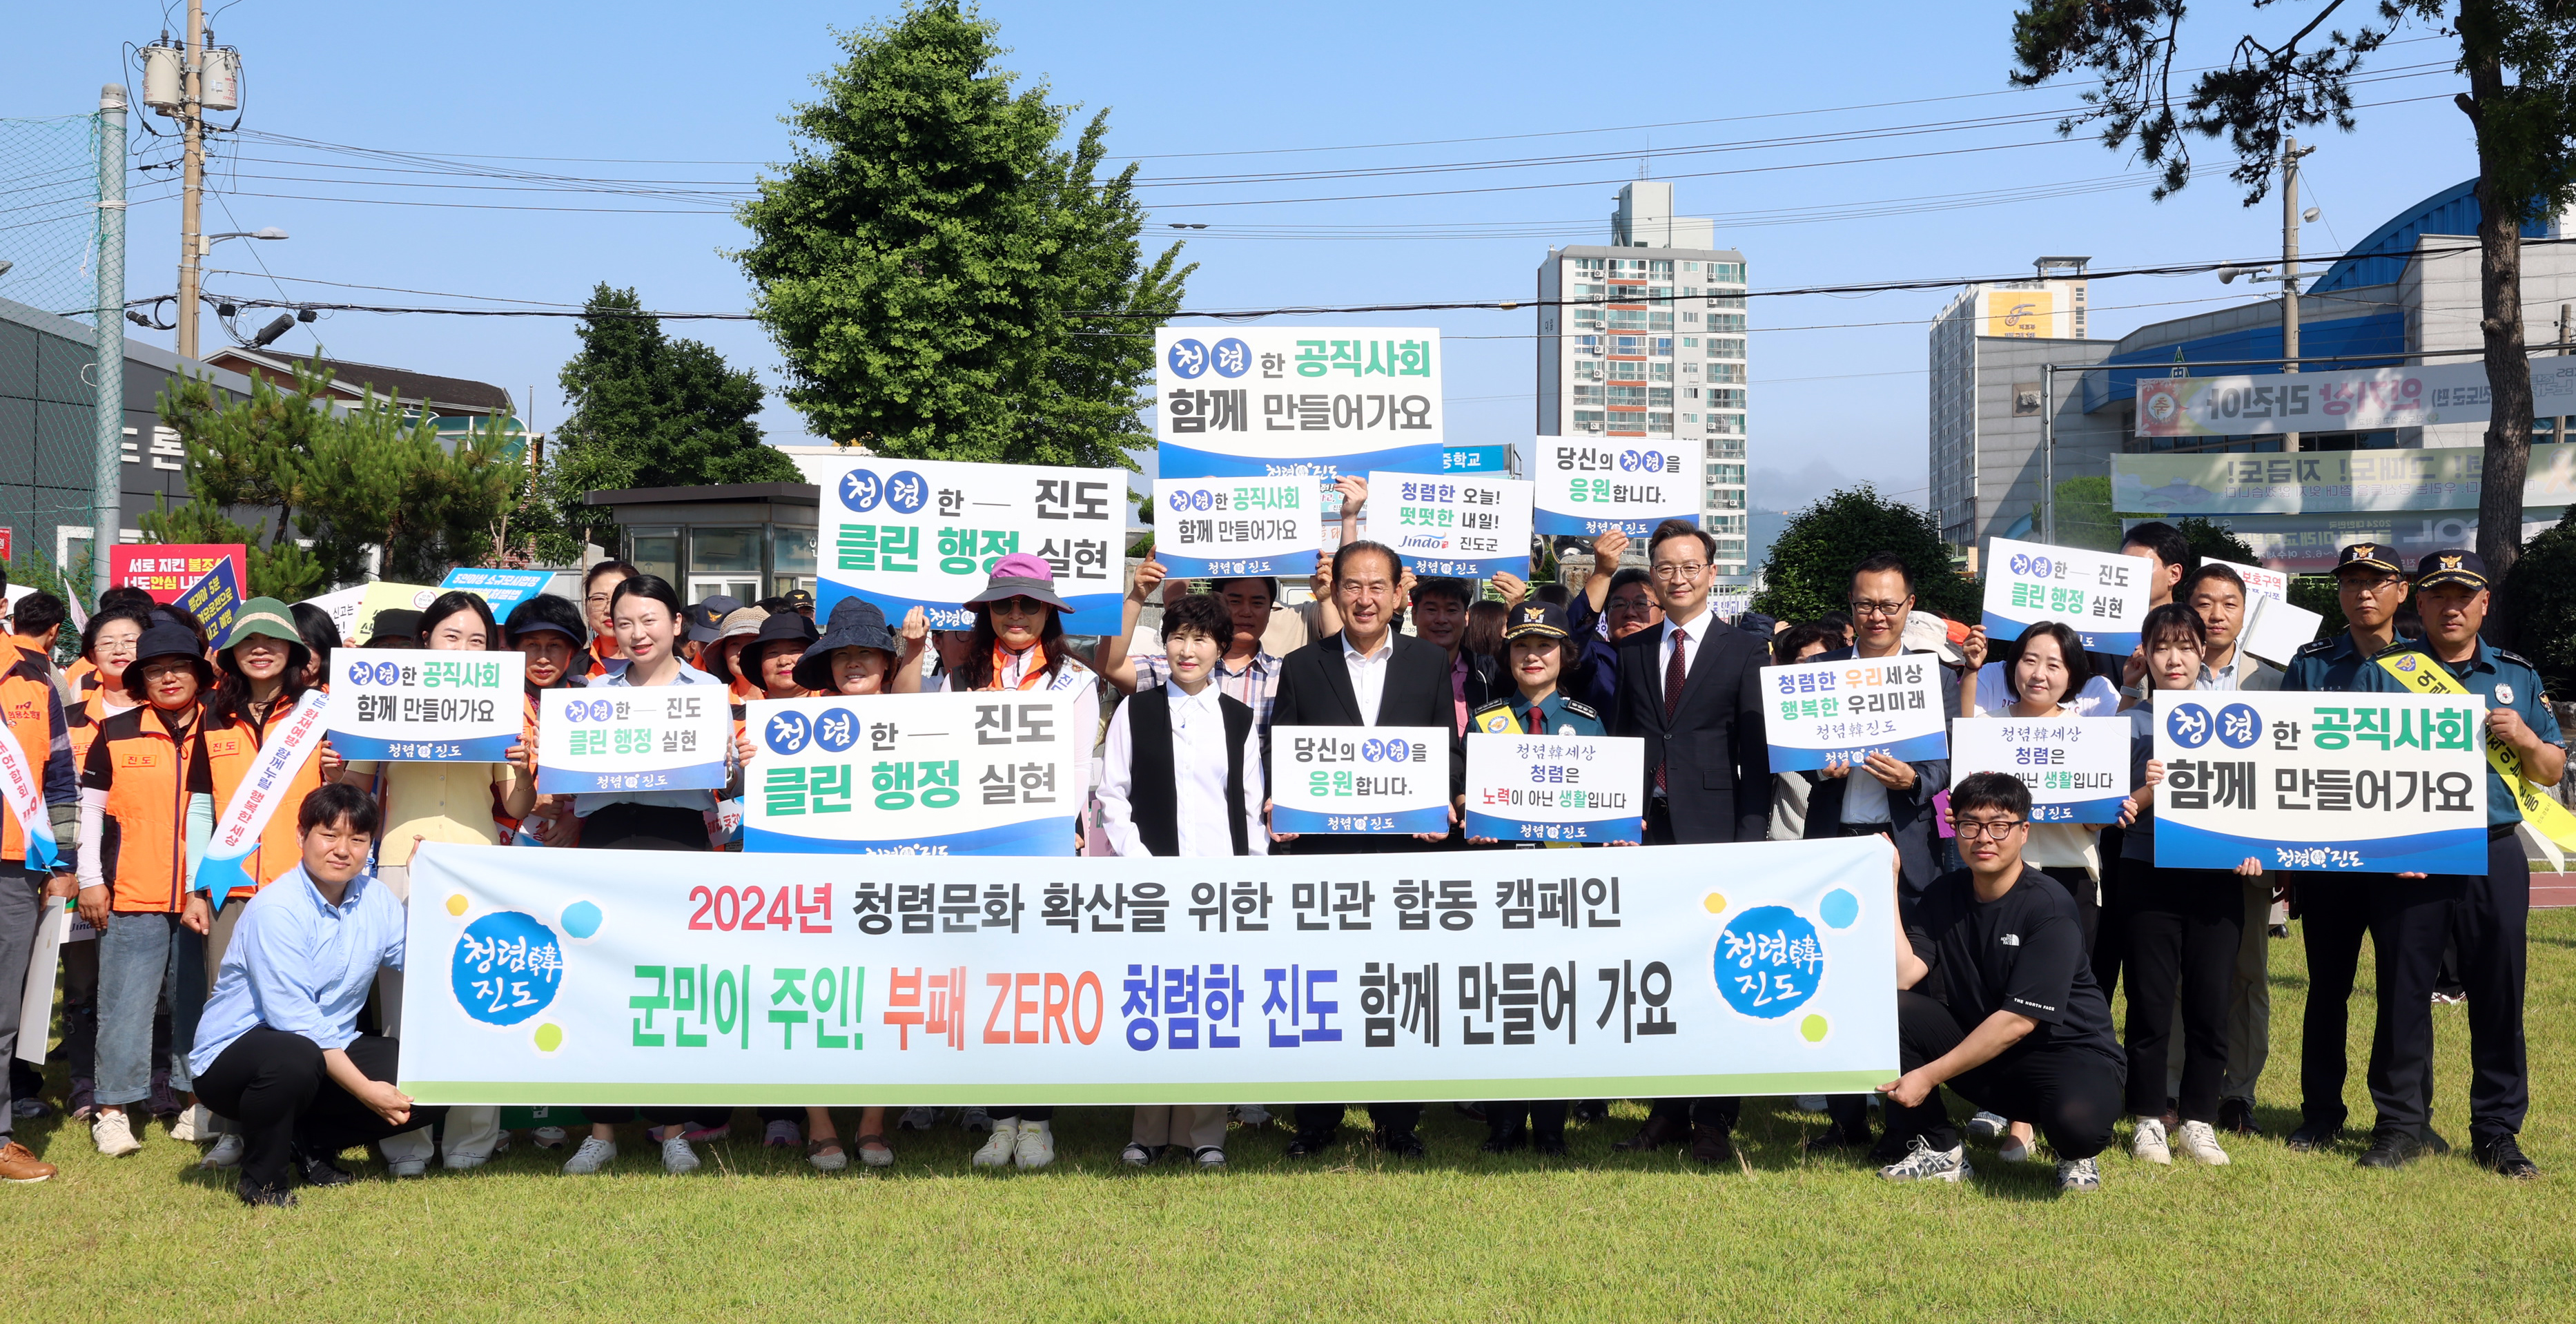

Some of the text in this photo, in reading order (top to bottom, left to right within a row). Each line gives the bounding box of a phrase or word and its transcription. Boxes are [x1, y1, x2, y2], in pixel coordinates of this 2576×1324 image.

[1168, 338, 1430, 379] 청렴한 공직사회
[1169, 389, 1432, 434] 함께 만들어가요
[1444, 452, 1481, 468] 중학교
[1557, 447, 1681, 473] 당신의 청렴을
[839, 469, 1109, 520] 청렴한 진도
[1169, 486, 1299, 512] 청렴한 공직사회
[1402, 483, 1500, 505] 청렴한 오늘!
[1570, 478, 1666, 503] 응원합니다.
[1401, 507, 1499, 529] 떳떳한 내일!
[1178, 520, 1212, 544] 함께
[1219, 520, 1297, 543] 만들어가요
[1398, 534, 1441, 549] Jindo
[1460, 536, 1498, 552] 진도군
[837, 524, 918, 572] 클린
[938, 529, 1019, 575] 행정
[1037, 538, 1106, 579] 실현
[128, 558, 222, 572] 서로 지킨 불조
[2009, 554, 2129, 587] 청렴한 진도
[208, 575, 221, 595] 5분
[2243, 571, 2281, 590] 보호구역
[333, 604, 353, 619] 신고는
[2011, 582, 2123, 619] 클린 행정 실현
[349, 661, 500, 688] 청렴한 공직사회
[1778, 664, 1923, 695] 청렴한 우리세상
[8, 711, 40, 720] 의용소방대
[358, 694, 494, 723] 함께 만들어가요
[565, 697, 701, 723] 청렴한 진도
[1780, 689, 1926, 721] 행복한 우리미래
[286, 708, 319, 748] 화재예방
[765, 704, 1055, 755] 청렴한 진도
[2167, 702, 2473, 752] 청렴한 공직사회
[213, 741, 235, 752] 진도
[569, 728, 696, 756] 클린 행정 실현
[1294, 737, 1427, 763] 당신의 청렴을
[128, 756, 151, 765] 진도
[2015, 747, 2065, 765] 청렴은
[1309, 770, 1413, 797] 응원합니다.
[1530, 765, 1579, 784] 청렴은
[2044, 772, 2114, 790] 생활입니다
[2167, 759, 2475, 812] 함께 만들어가요
[763, 760, 1055, 816] 클린 행정 실현
[1483, 788, 1627, 810] 노력이 아닌 생활입니다
[239, 789, 266, 825] 행복한
[225, 824, 246, 848] 세상
[688, 876, 1622, 935] 2024년 청렴문화 확산을 위한 민관 합동 캠페인
[70, 923, 92, 933] Jin
[472, 977, 538, 1013] 진도
[1735, 968, 1802, 1003] 진도
[628, 959, 1677, 1051] 군민이 주인! 부패 ZERO 청렴한 진도 함께 만들어 가요
